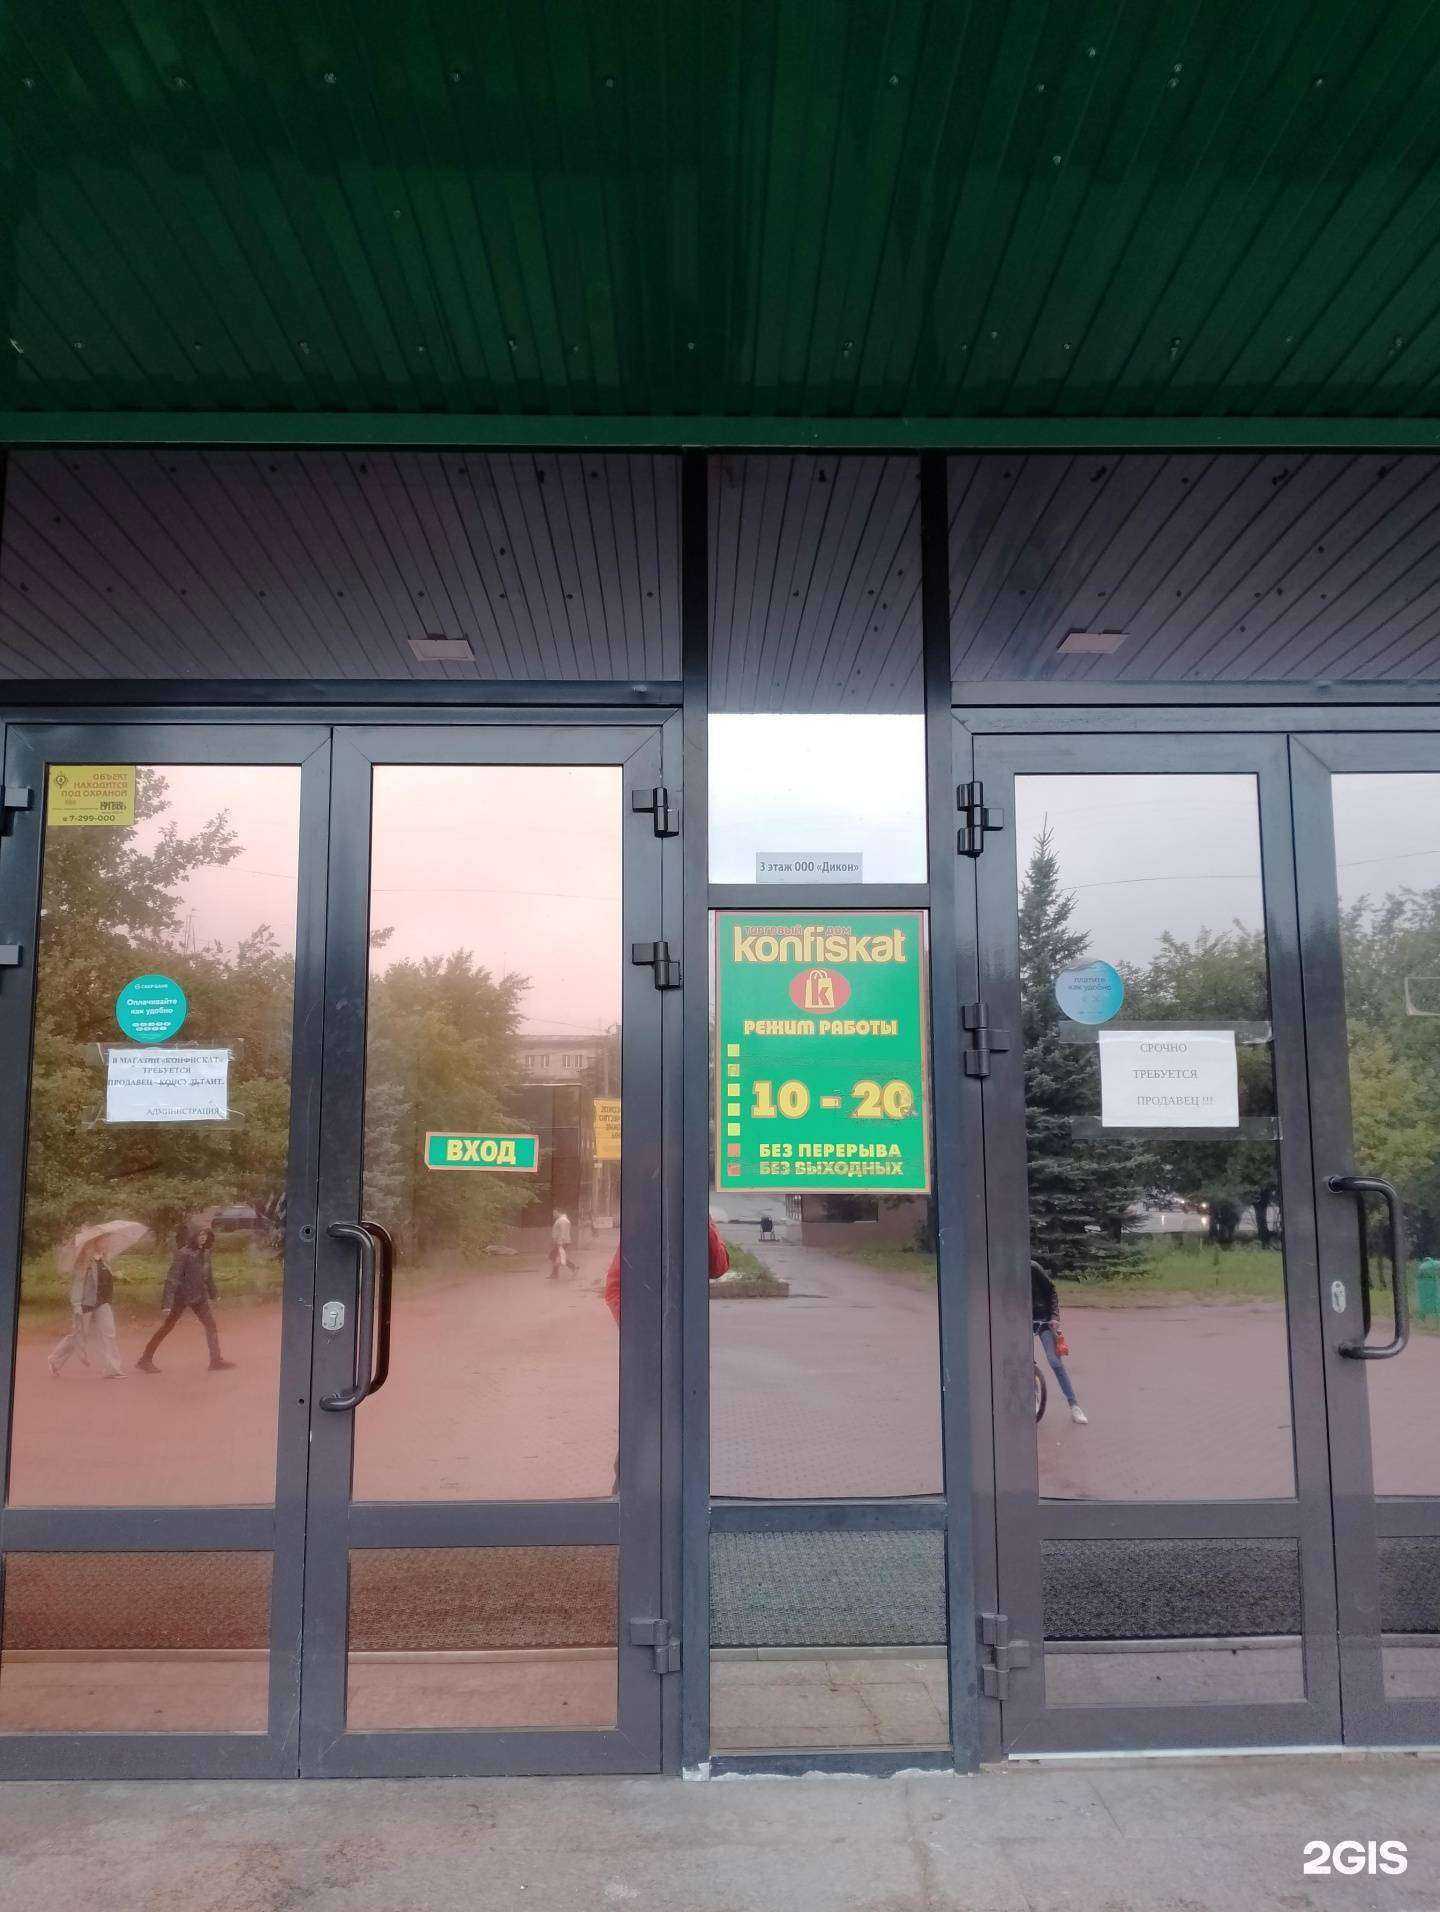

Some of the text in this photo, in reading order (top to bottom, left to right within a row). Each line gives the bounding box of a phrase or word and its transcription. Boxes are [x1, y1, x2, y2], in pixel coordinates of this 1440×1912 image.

[61, 789, 128, 798] ПОД ОХРАНОЙ
[759, 861, 859, 873] 3 этаж ООО «Дикон»
[733, 925, 907, 963] konfiskat
[127, 998, 177, 1008] Оплачивайте
[146, 1007, 174, 1016] удобно
[819, 1020, 898, 1035] РАБОТЫ
[1140, 1043, 1187, 1053] СРОЧНО
[1133, 1069, 1198, 1080] ТРЕБУЕТСЯ
[108, 1079, 152, 1087] ПРОДАВЕЦ
[751, 1080, 810, 1119] 10
[849, 1080, 914, 1119] 20
[1137, 1095, 1199, 1107] ПРОДАВЕЦ
[446, 1139, 516, 1164] ВХОД
[759, 1144, 902, 1157] БЕЗ ПЕРЕРЫВА
[759, 1162, 904, 1177] БЕЗ ВЫХОДНЫХ
